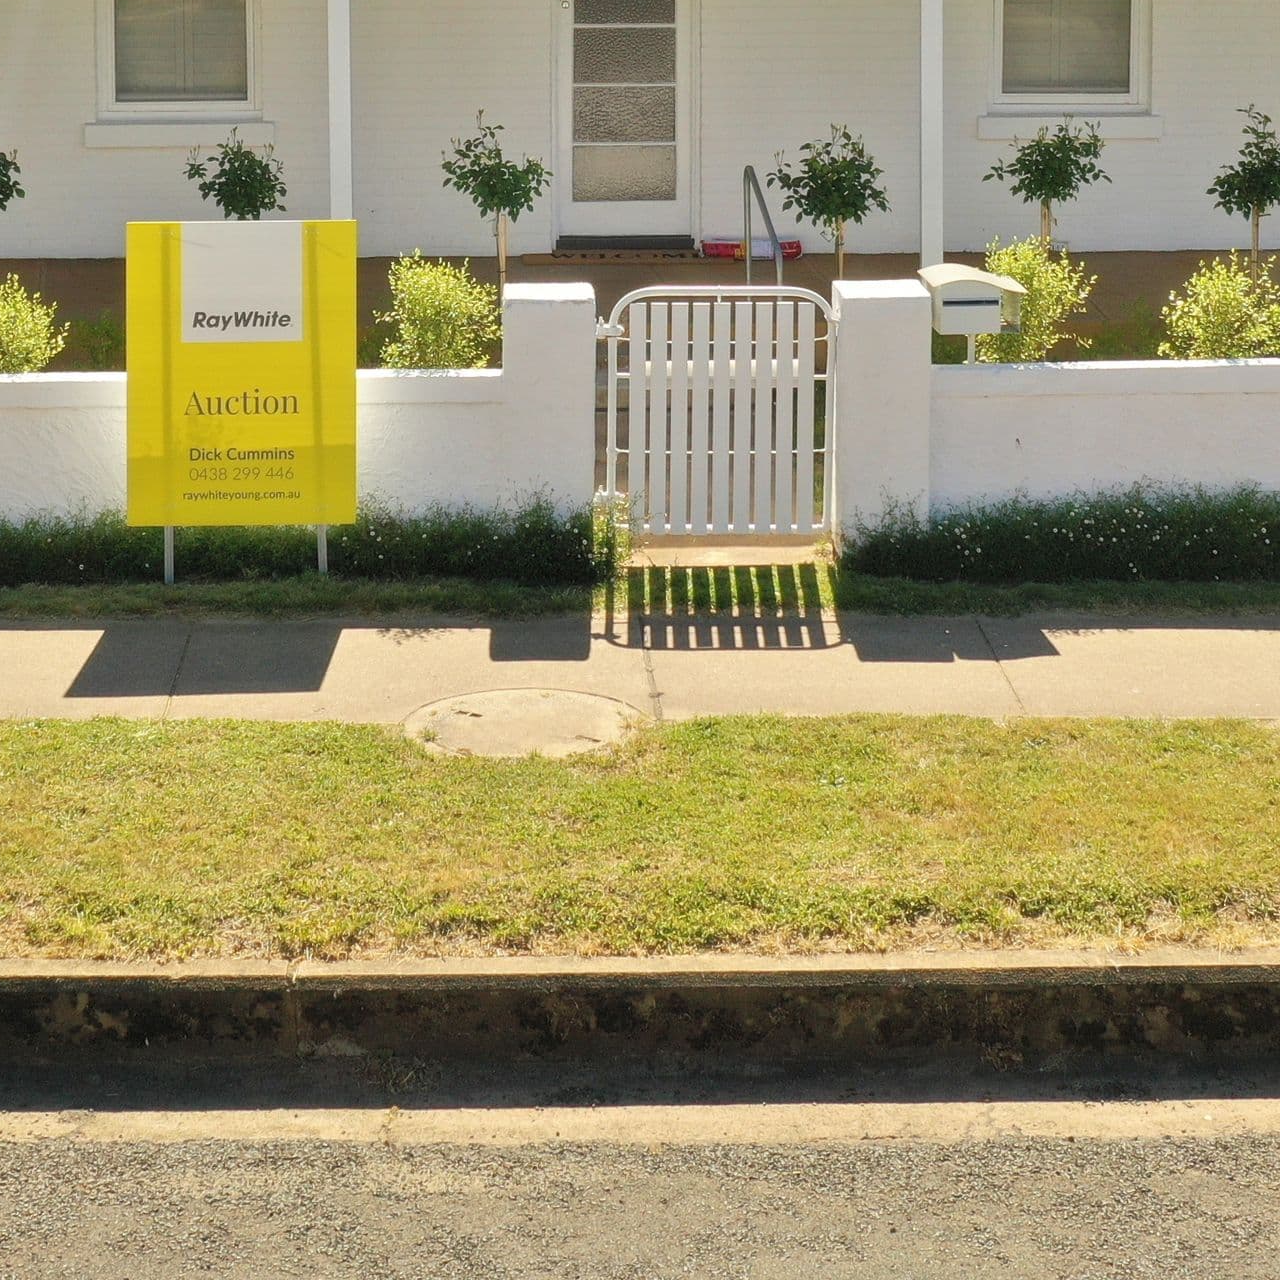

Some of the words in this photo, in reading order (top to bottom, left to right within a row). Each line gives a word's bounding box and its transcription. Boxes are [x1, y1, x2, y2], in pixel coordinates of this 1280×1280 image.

[184, 388, 299, 416] Auction
[189, 448, 222, 461] Dick
[226, 447, 295, 461] Cummins
[189, 468, 228, 481] 0438
[232, 466, 261, 481] 299
[265, 466, 295, 480] 446
[183, 489, 301, 501] raywhiteyoung.com.au
